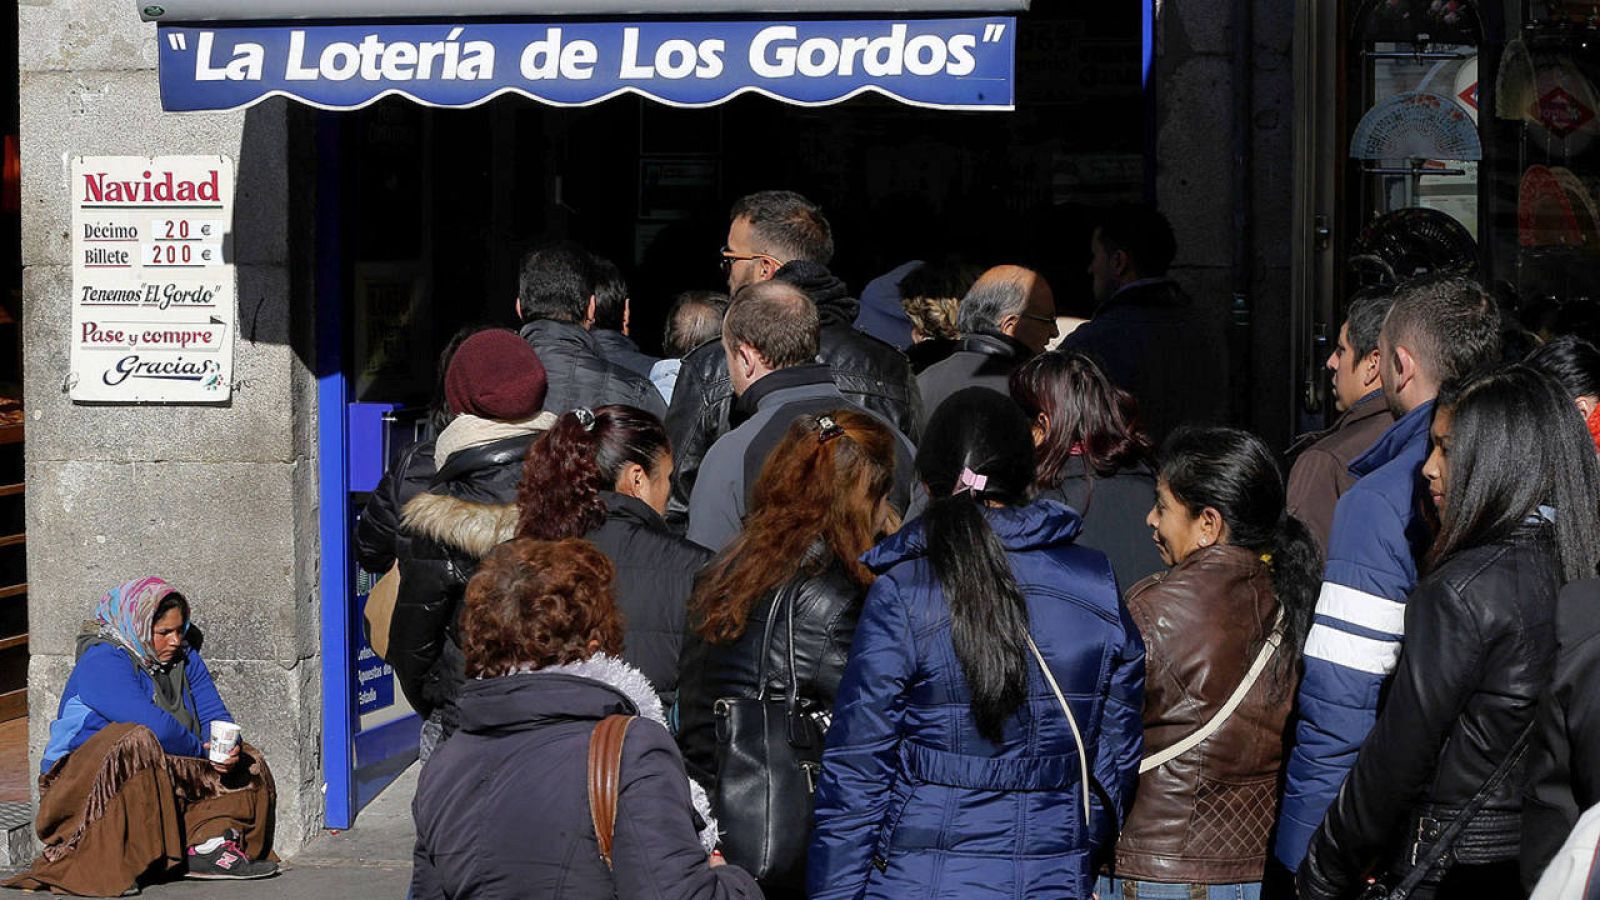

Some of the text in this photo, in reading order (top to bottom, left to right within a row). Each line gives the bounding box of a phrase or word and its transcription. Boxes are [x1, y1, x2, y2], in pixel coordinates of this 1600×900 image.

[284, 27, 496, 81] Lotería
[519, 27, 598, 81] de
[619, 26, 726, 80] Los
[748, 23, 1006, 79] Gordos"
[82, 169, 221, 202] Navidad
[83, 221, 138, 239] Décimo
[165, 219, 189, 238] 20
[84, 247, 130, 264] Billete
[152, 244, 191, 264] 200
[81, 285, 142, 302] Tenemos
[159, 283, 222, 311] Gordo"
[81, 321, 213, 349] Pase y compre
[102, 355, 213, 387] Gracias
